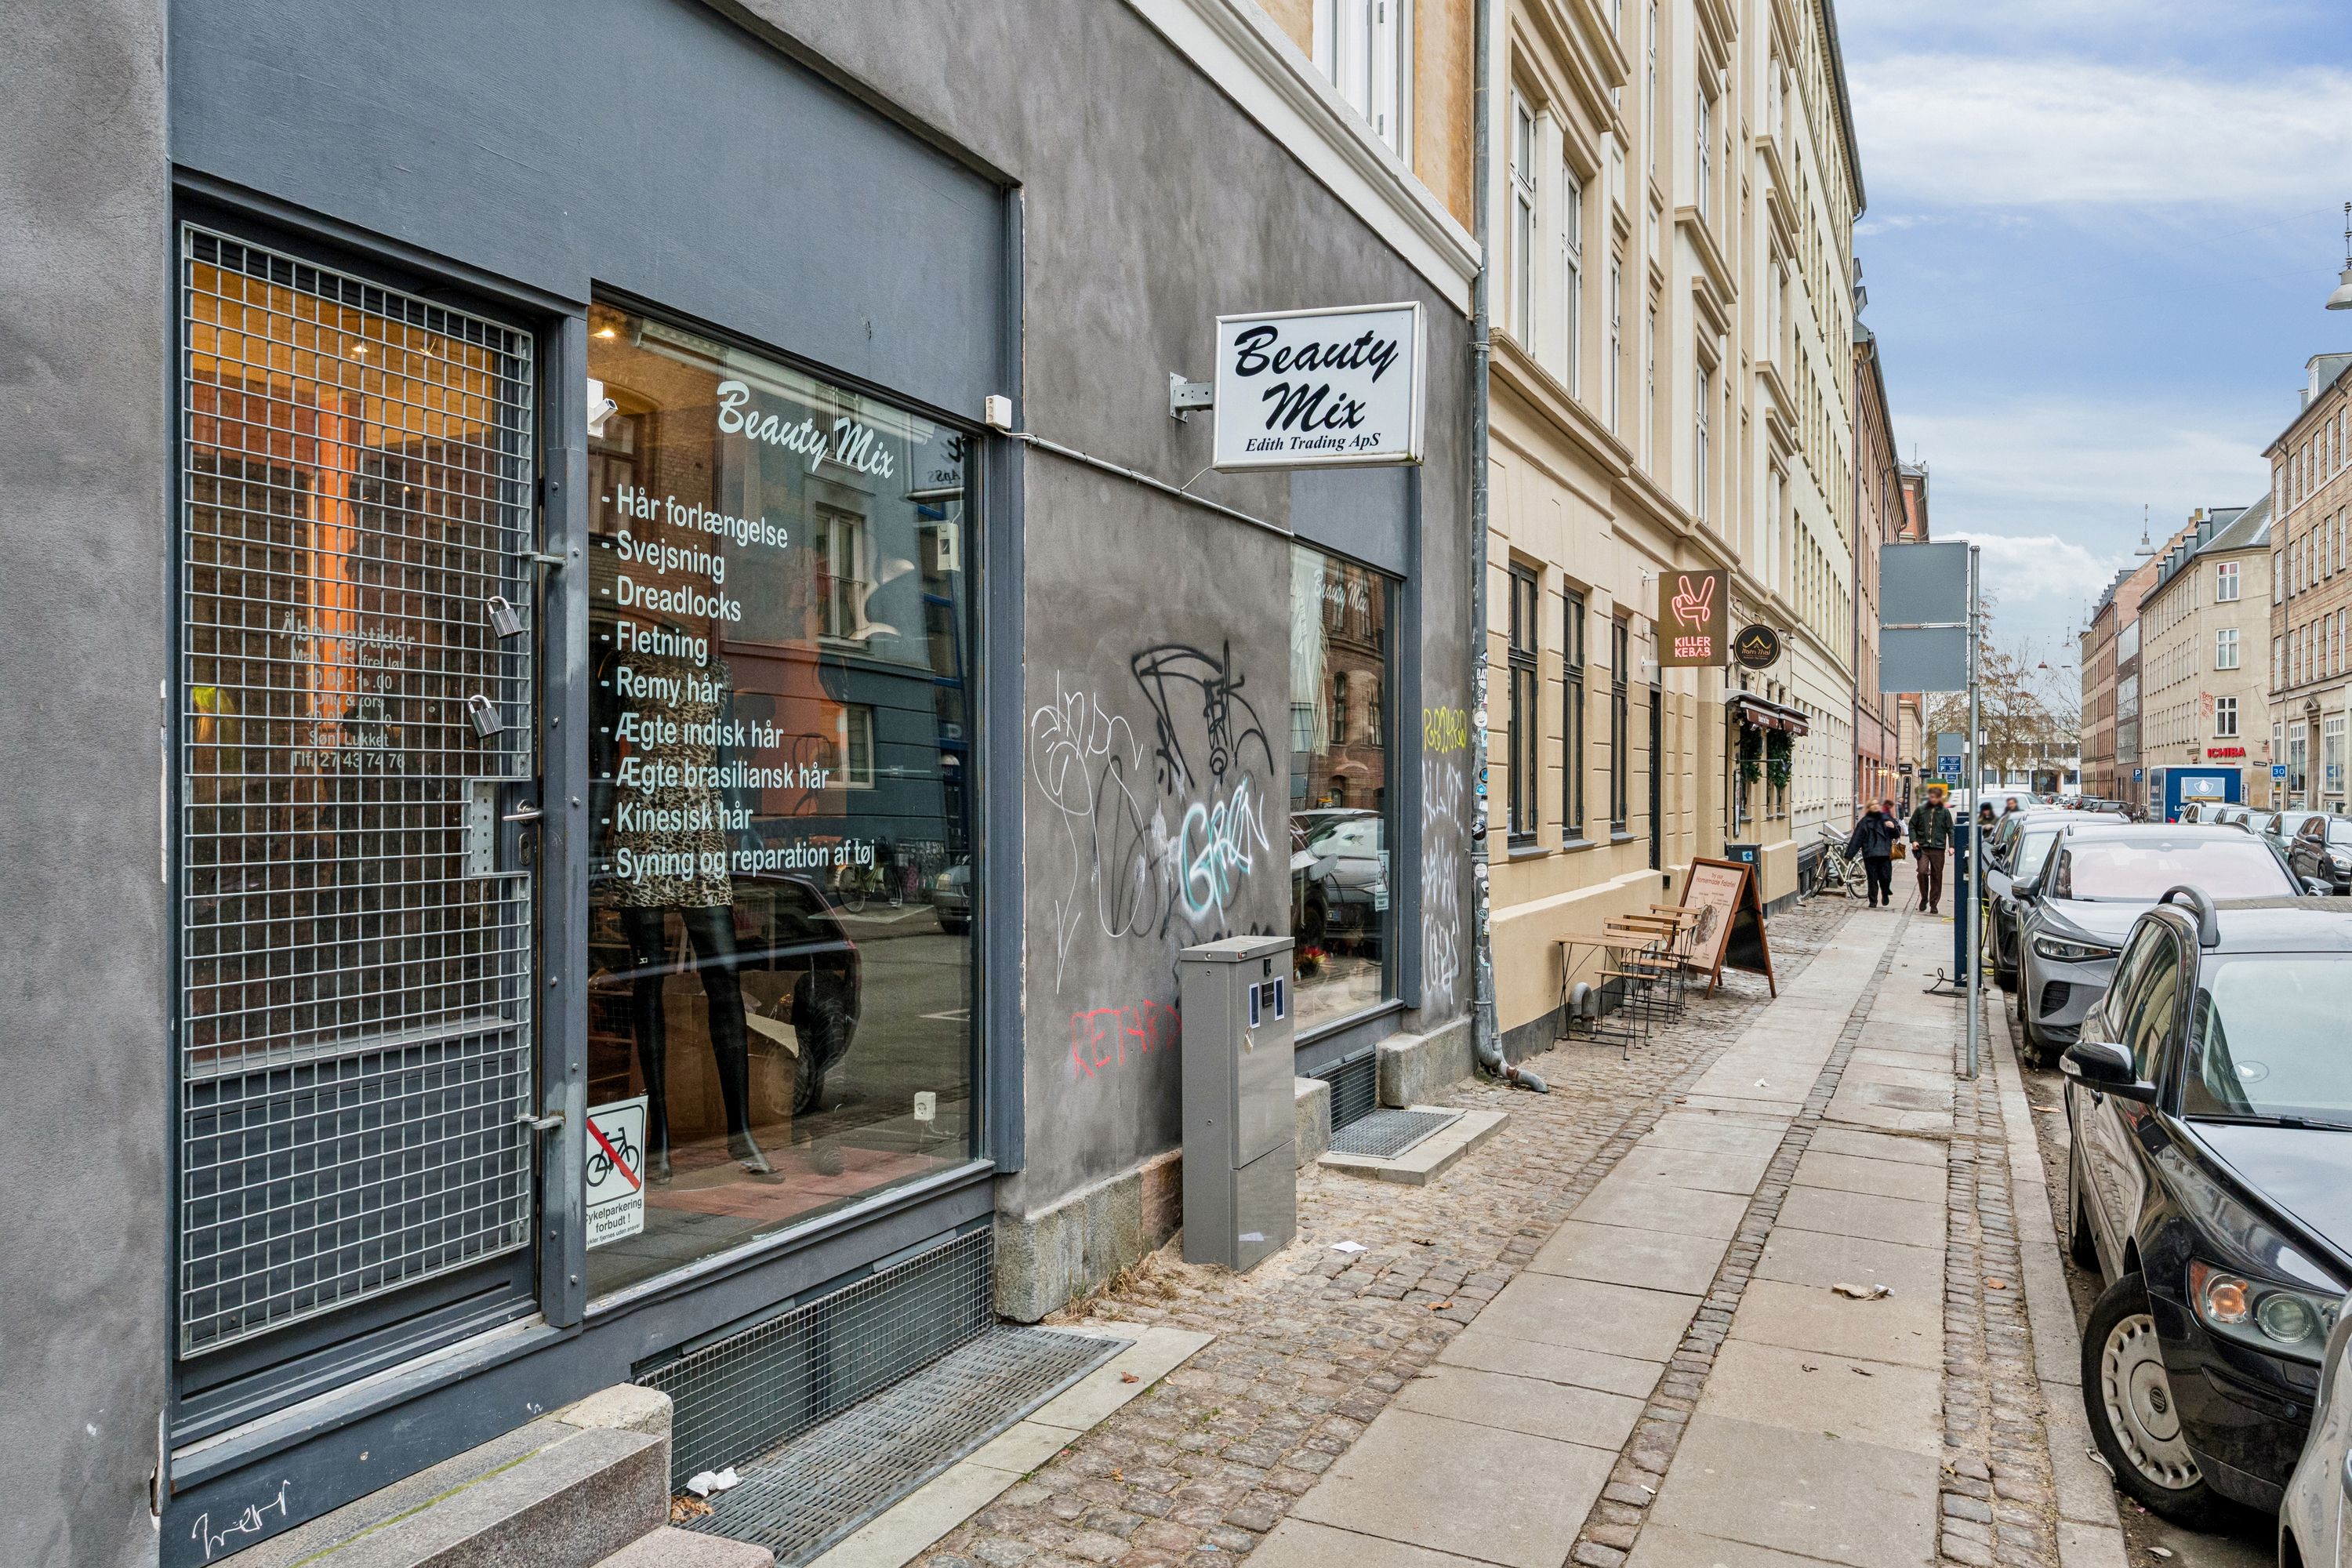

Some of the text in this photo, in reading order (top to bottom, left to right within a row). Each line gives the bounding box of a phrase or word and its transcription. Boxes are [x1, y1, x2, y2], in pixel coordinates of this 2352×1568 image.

[1234, 325, 1399, 383] Beauty
[1261, 382, 1367, 432] Mix
[717, 380, 895, 479] Beauty Mix
[1245, 432, 1381, 452] Edith Trading ApS
[617, 483, 660, 521] Hår
[666, 495, 788, 548] forlængelse
[617, 529, 725, 584] Svejsning
[617, 575, 742, 622] Dreadlocks
[1313, 568, 1346, 613] Beauty
[617, 620, 707, 666] Fletning
[1675, 636, 1711, 647] KILLER
[1675, 646, 1711, 658] KEBAB
[617, 666, 681, 708] Remy
[687, 672, 724, 703] hår
[345, 728, 390, 747] Lukket
[615, 712, 677, 750] Ægte
[684, 717, 746, 747] indisk
[751, 719, 784, 748] hår
[320, 752, 338, 768] 27
[343, 753, 360, 768] 43
[366, 753, 383, 768] 74
[388, 753, 405, 768] 76
[2207, 747, 2246, 758] ICHIBA
[616, 757, 678, 795] Ægte
[684, 758, 794, 789] brasiliansk
[800, 761, 829, 789] hår
[617, 801, 713, 833] Kinesisk
[719, 800, 753, 830] hår
[617, 847, 694, 885] Syning
[700, 851, 726, 880] og
[732, 841, 829, 877] reparation
[833, 840, 851, 866] af
[854, 839, 875, 870] tøj
[586, 1237, 598, 1246] ykler
[596, 1216, 626, 1232] forbudt
